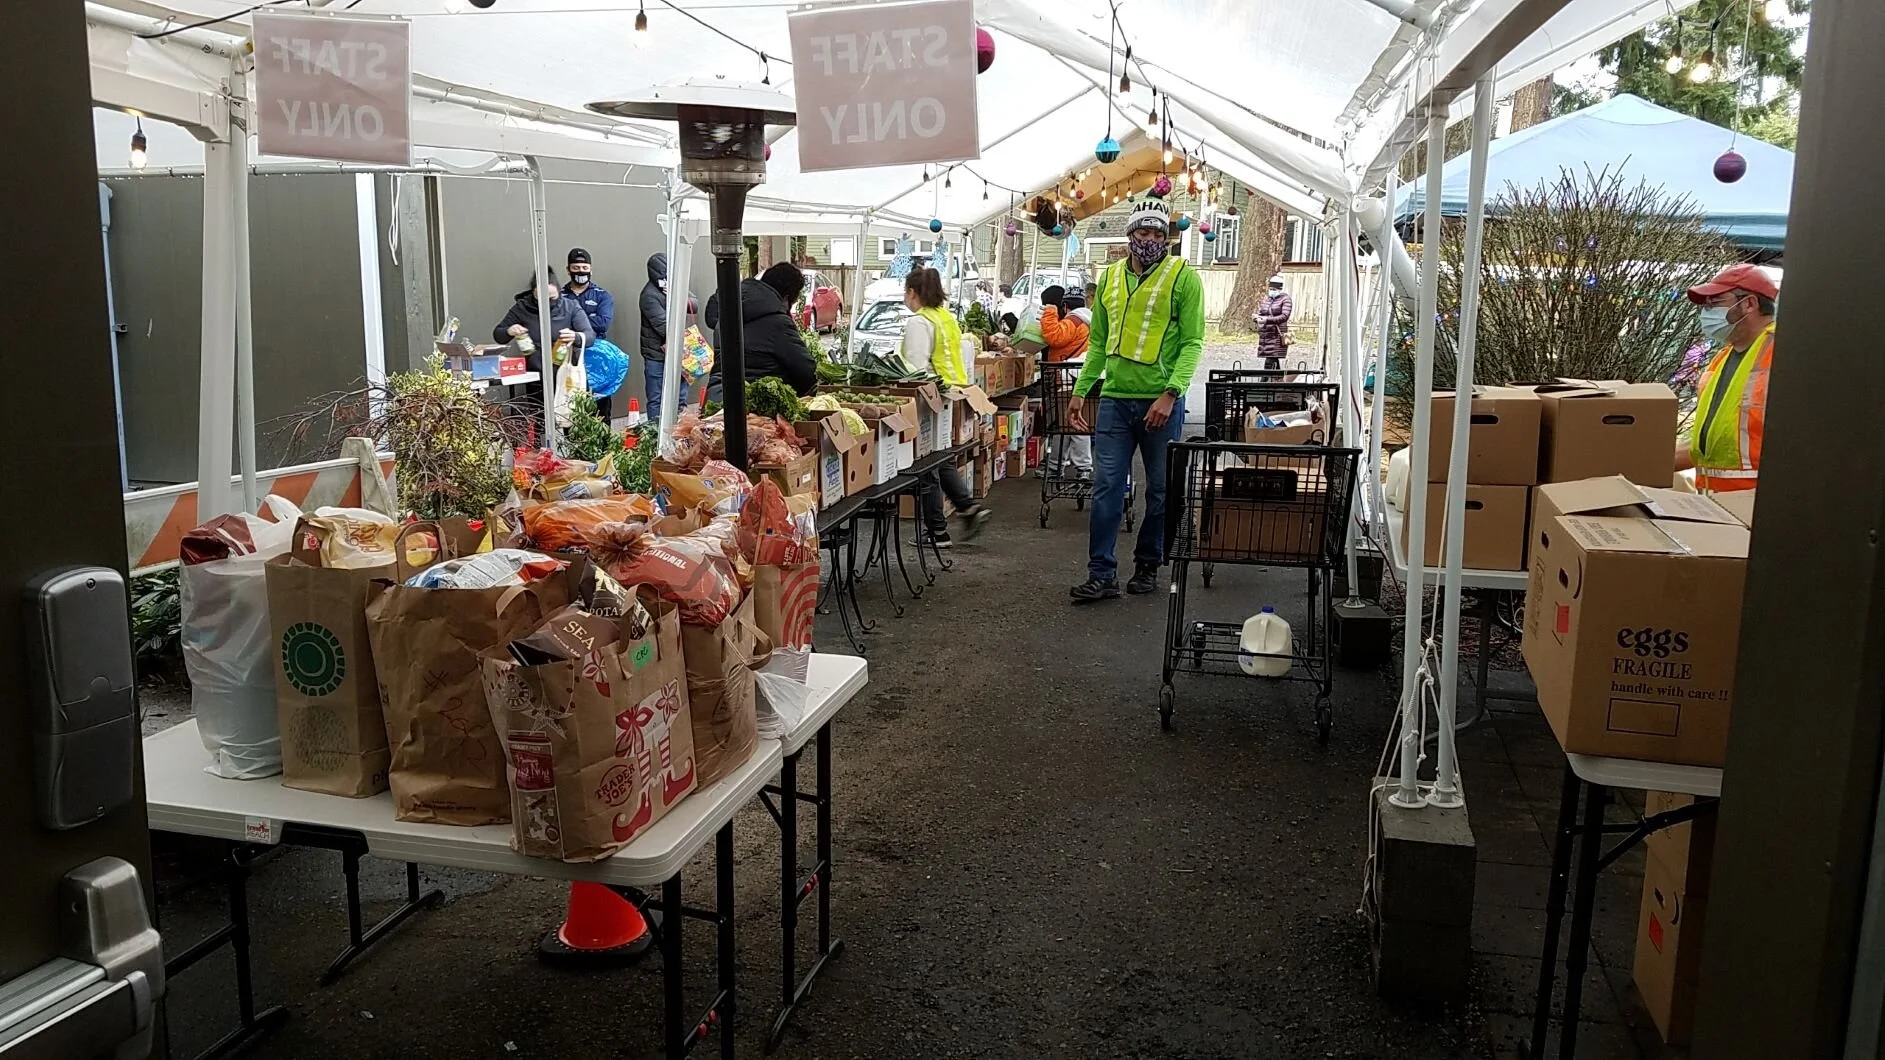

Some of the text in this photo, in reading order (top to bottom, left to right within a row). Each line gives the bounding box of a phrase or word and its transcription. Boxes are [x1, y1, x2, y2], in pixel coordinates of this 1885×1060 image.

[562, 620, 596, 651] SEA
[1616, 626, 1690, 659] eggs
[1612, 657, 1693, 681] FRAGILE
[1610, 680, 1653, 695] handle
[1656, 684, 1684, 698] with
[1687, 689, 1715, 701] care
[595, 763, 636, 800] TRADER
[604, 776, 633, 805] JOE'S
